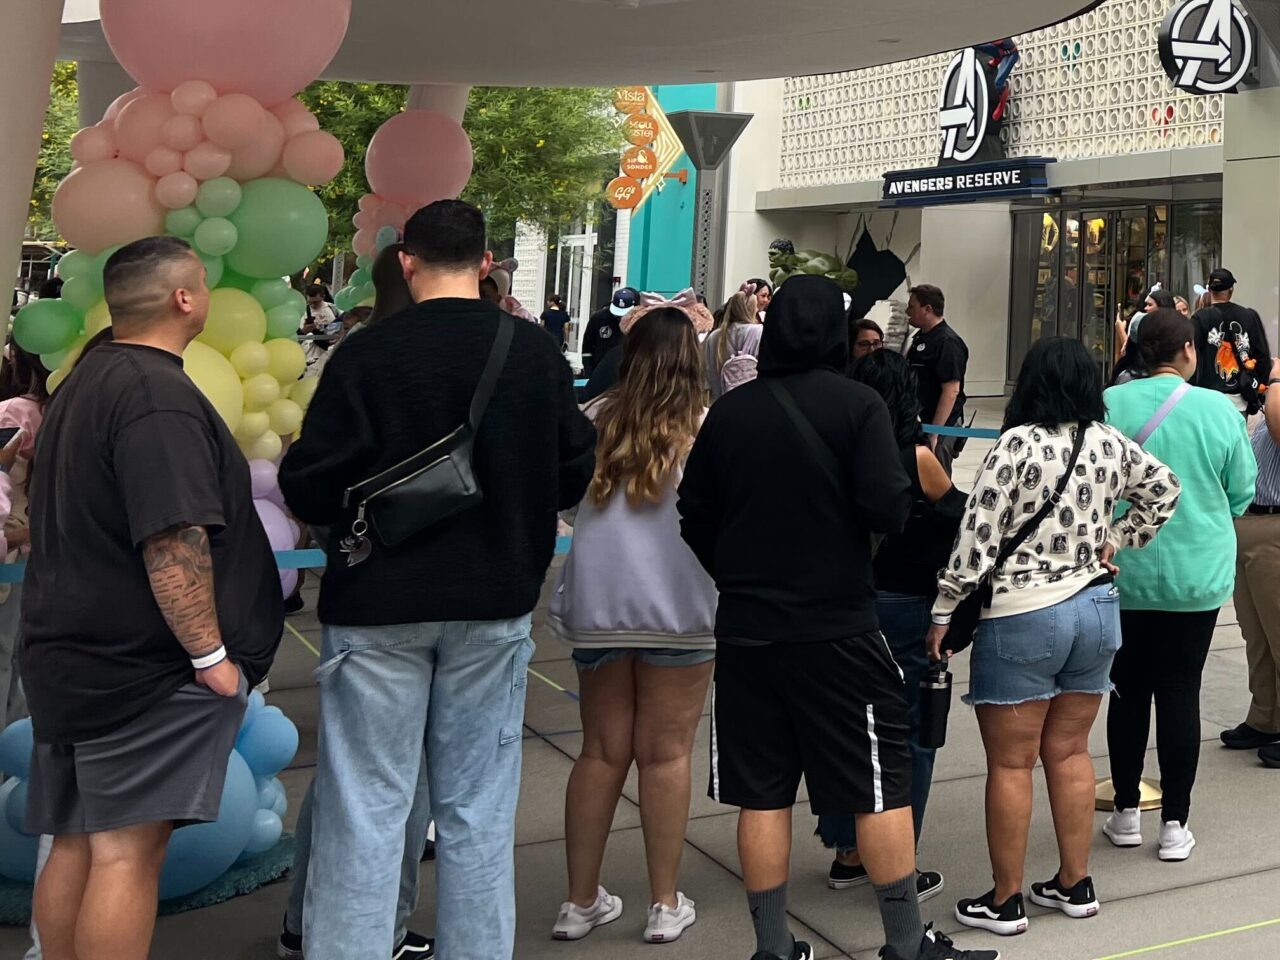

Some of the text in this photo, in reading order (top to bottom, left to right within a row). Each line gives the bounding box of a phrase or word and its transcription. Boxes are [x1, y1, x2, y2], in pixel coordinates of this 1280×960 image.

[617, 90, 645, 101] Vista
[889, 170, 1021, 194] AVENGERS RESERVE
